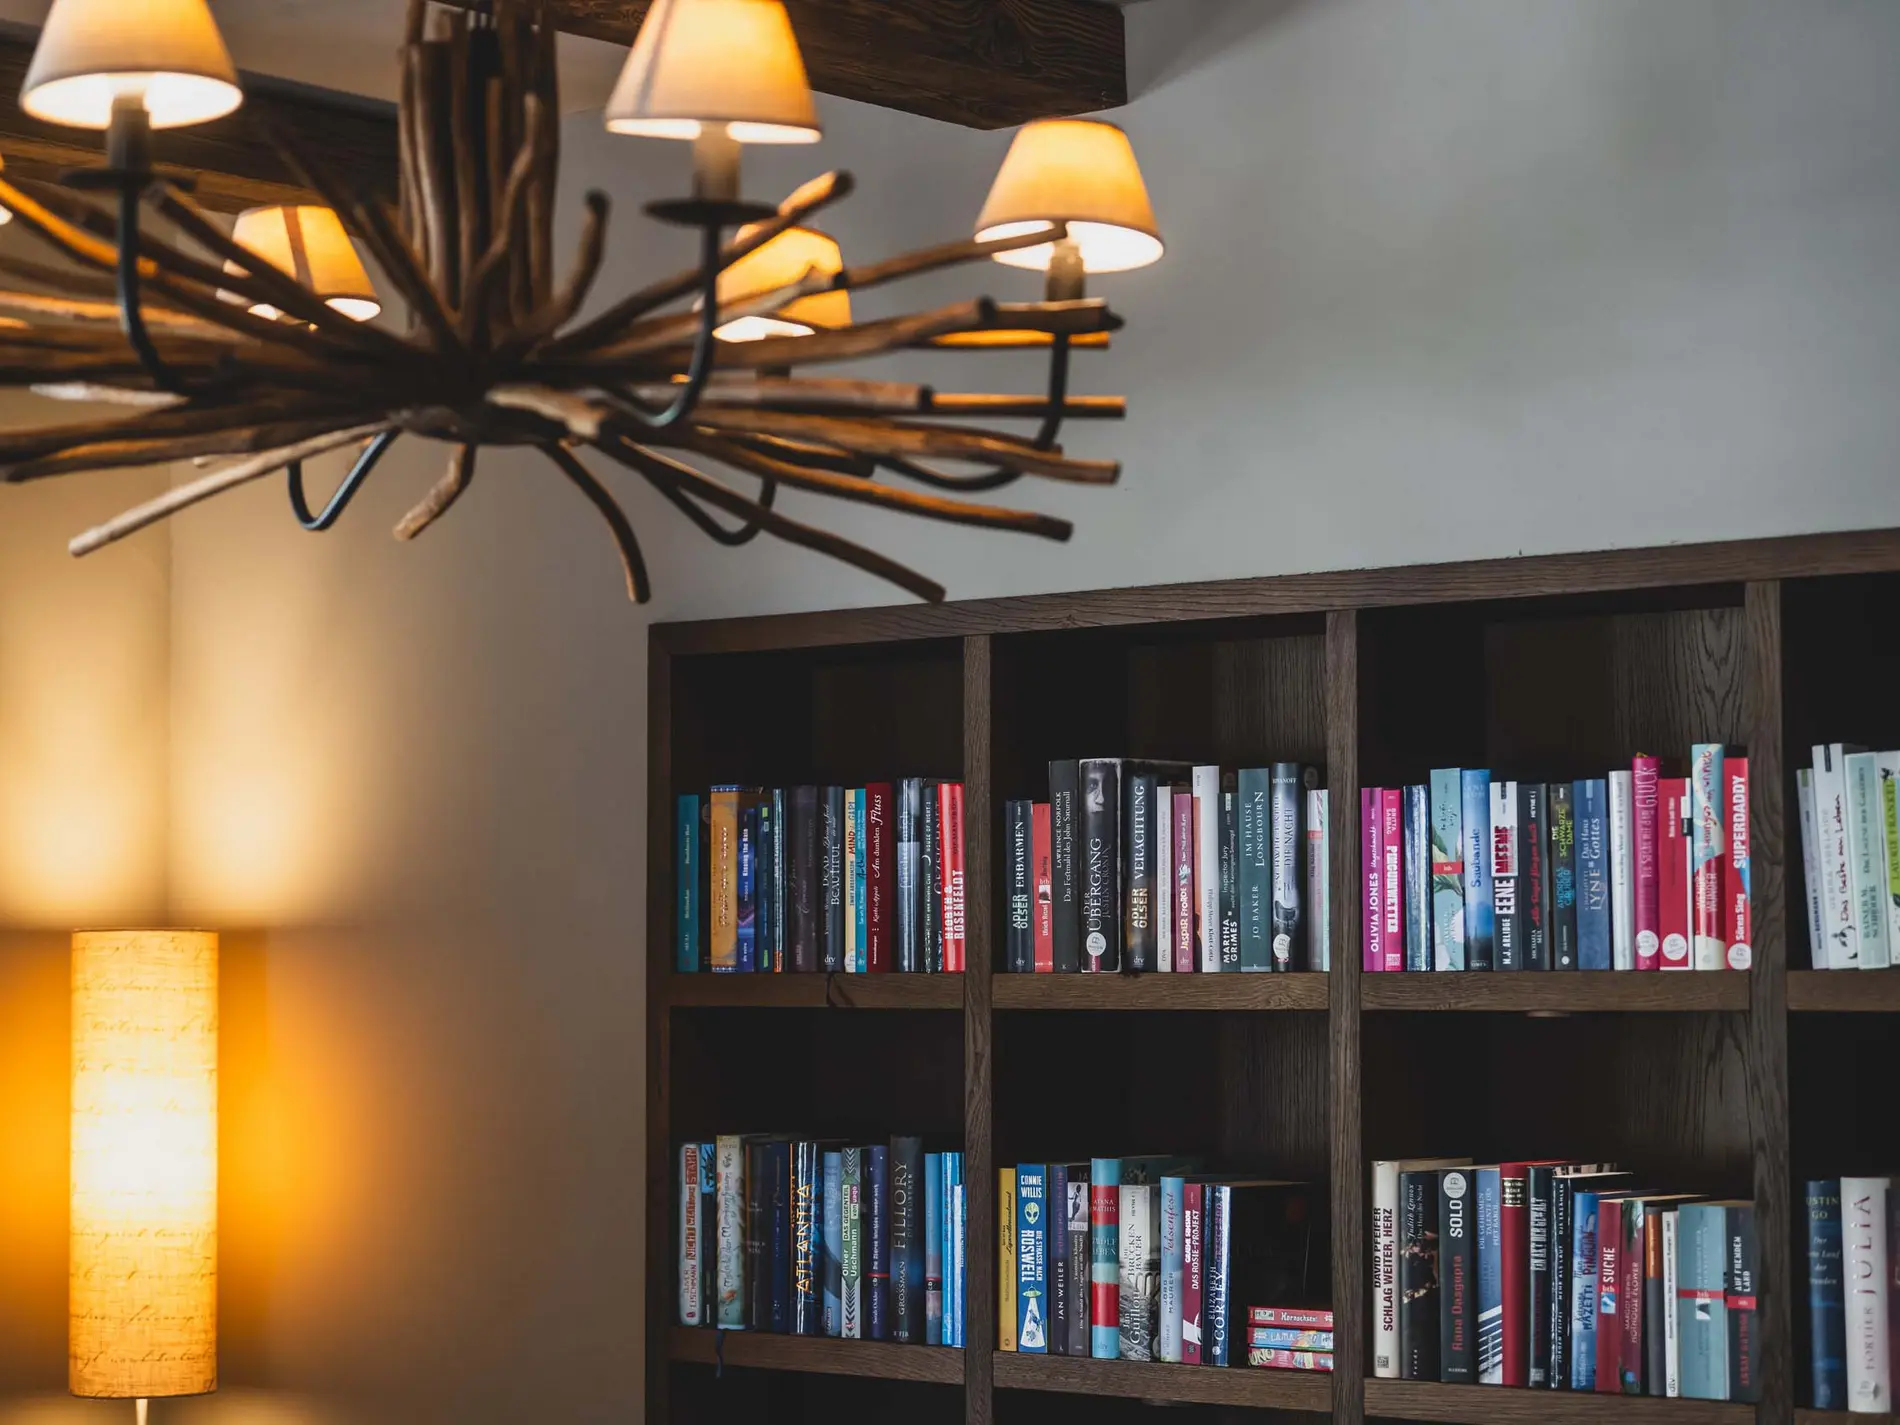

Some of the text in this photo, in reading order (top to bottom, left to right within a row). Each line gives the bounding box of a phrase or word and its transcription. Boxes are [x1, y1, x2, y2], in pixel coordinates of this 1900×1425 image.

[1062, 791, 1071, 821] Saturnall
[1732, 775, 1746, 868] SUPERDADDY
[1833, 794, 1844, 832] Leben
[870, 793, 883, 878] Am dunklen Fluss
[1063, 822, 1073, 841] John
[1063, 842, 1071, 853] des
[1134, 785, 1145, 880] VERACHTUNG
[1244, 802, 1252, 857] IM HAUSE
[1254, 791, 1265, 867] LONGBOURN
[1284, 808, 1293, 866] DIE NACHT
[1494, 825, 1512, 873] MEENE
[1559, 807, 1567, 857] SCHWARZE
[1566, 820, 1574, 844] DAME
[1581, 819, 1590, 859] Das Haus
[1589, 818, 1601, 859] Gottes
[1885, 781, 1900, 880] LAURIE FRANKEL
[830, 844, 840, 905] BEAUTIFUL
[1015, 821, 1024, 888] ERBARMEN
[1063, 854, 1071, 886] Festmahl
[1221, 845, 1230, 892] Inspector Jury
[1470, 828, 1482, 887] Saubande
[1086, 837, 1102, 931] ÜBERGANG
[1102, 845, 1111, 919] JUSTIN CRONIN
[1386, 846, 1398, 934] PINGUINWETTER
[1494, 878, 1516, 914] EENE
[1556, 867, 1565, 908] ANDREAS
[1564, 869, 1572, 906] GRUBER
[1590, 868, 1602, 910] LYNE
[1705, 872, 1718, 912] WUNDER
[1837, 861, 1848, 894] Beste
[952, 870, 964, 940] ROSENFELDT
[1012, 895, 1020, 929] ADLER
[1020, 894, 1028, 929] OLSEN
[1083, 892, 1091, 915] DER
[1132, 888, 1140, 928] ADLER
[1140, 888, 1148, 928] OLSEN
[1369, 872, 1380, 952] OLIVIA JONES
[1734, 893, 1746, 913] Sieg
[1840, 900, 1849, 921] Das
[1180, 918, 1189, 951] JASPER
[1252, 927, 1260, 940] JO
[1020, 1175, 1042, 1186] CONNIE
[1020, 1186, 1042, 1198] WILLIS
[686, 1148, 697, 1260] NICHT WEIT STAMM
[894, 1160, 907, 1249] FILLORY
[1163, 1192, 1178, 1256] Felsenfest
[1407, 1184, 1416, 1238] Judith Lennox
[1449, 1200, 1464, 1238] SOLO
[1531, 1197, 1547, 1227] GEWALT
[1812, 1211, 1828, 1220] GO
[796, 1183, 812, 1293] ATLANTIA
[850, 1229, 858, 1276] Uschmann
[1021, 1230, 1035, 1282] ROSWELL
[1192, 1210, 1200, 1273] ROSIE-PROJEKT
[1373, 1208, 1381, 1288] DAVID PFEIFER
[1531, 1243, 1546, 1258] AKT
[1583, 1231, 1597, 1276] PINGUIN
[1853, 1196, 1877, 1296] JULIA
[1383, 1208, 1394, 1331] SCHLAG WEITER, HERZ
[1603, 1247, 1616, 1283] SUCHE
[1631, 1262, 1639, 1296] FLOWER
[1743, 1271, 1751, 1292] LAND
[898, 1261, 906, 1315] GROSSMAN
[1208, 1266, 1217, 1320] ELIZABETH
[1214, 1271, 1225, 1340] CORLEY
[1452, 1255, 1465, 1350] Rana Dasgupta
[1583, 1285, 1594, 1330] MAZETTI
[1122, 1314, 1131, 1329] Jan
[1130, 1291, 1142, 1344] Guillou
[1863, 1307, 1875, 1370] FORTIER
[1249, 1348, 1275, 1366] UNO
